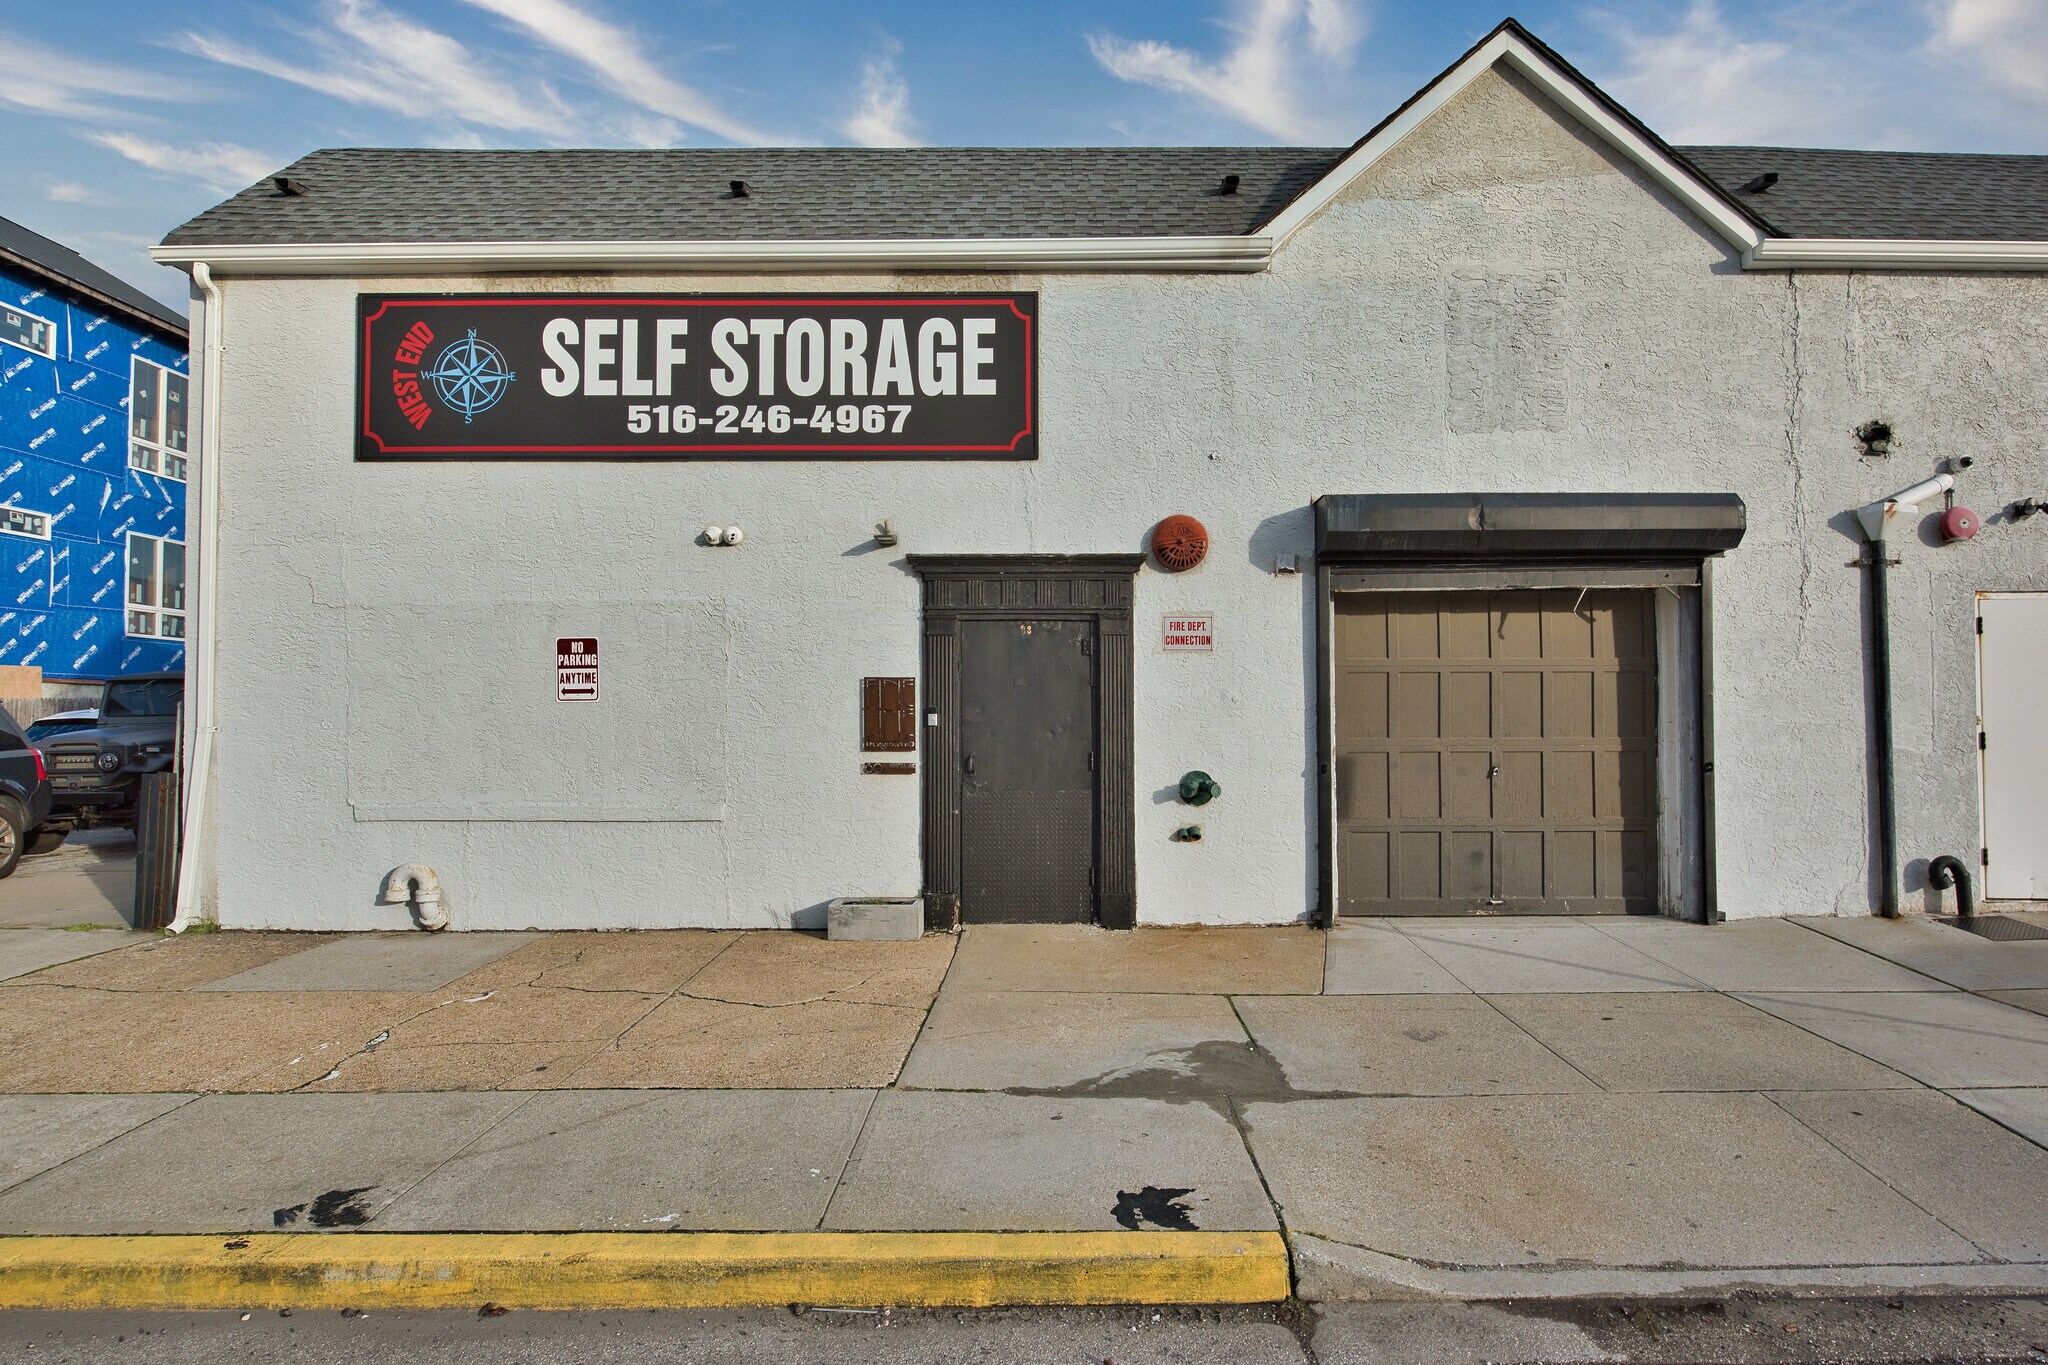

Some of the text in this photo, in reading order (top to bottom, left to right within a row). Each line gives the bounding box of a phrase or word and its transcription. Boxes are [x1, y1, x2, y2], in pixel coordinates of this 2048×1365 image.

[467, 328, 477, 338] N
[540, 317, 997, 397] SELF STORAGE
[393, 321, 434, 431] WEST END
[420, 370, 433, 380] W
[510, 371, 517, 381] E
[464, 413, 473, 424] S
[627, 405, 912, 434] 516-246-4967
[1169, 621, 1207, 631] FIRE DEPT.
[1165, 635, 1211, 646] CONNECTION
[571, 641, 584, 653] NO
[558, 653, 597, 666] PARKING
[560, 672, 597, 684] ANYTIME
